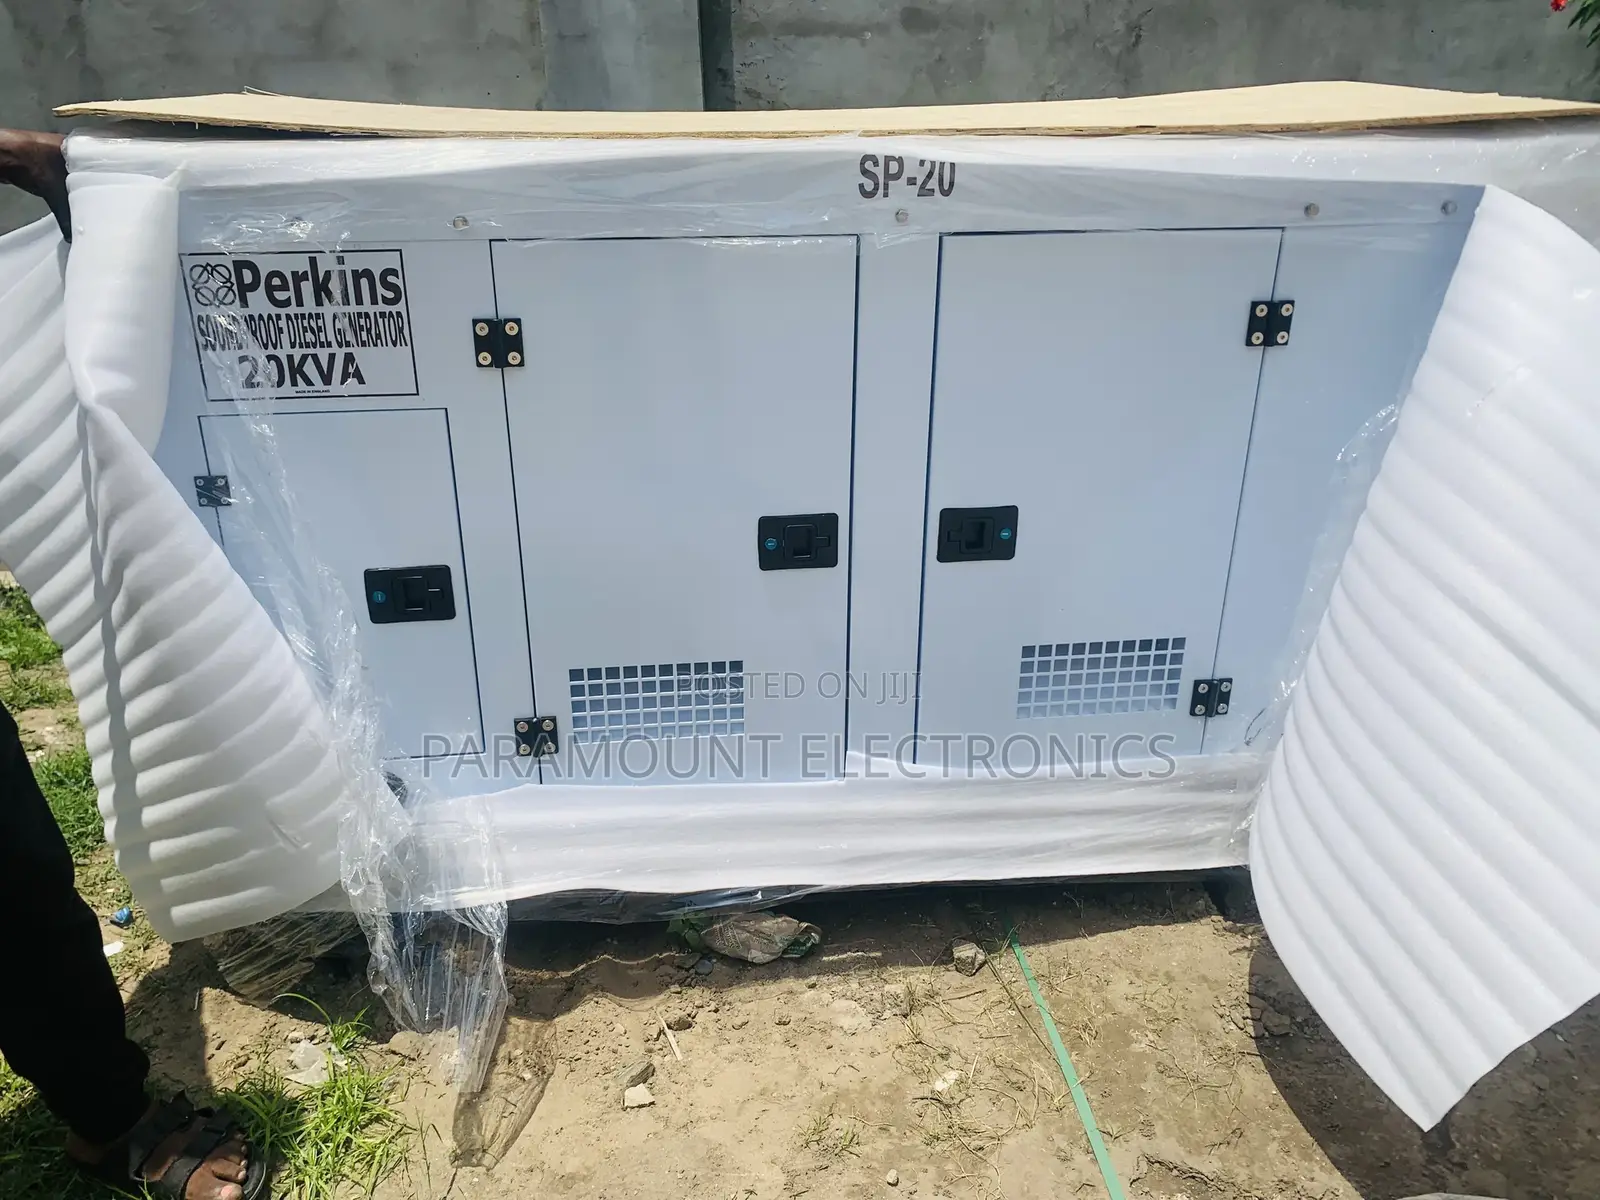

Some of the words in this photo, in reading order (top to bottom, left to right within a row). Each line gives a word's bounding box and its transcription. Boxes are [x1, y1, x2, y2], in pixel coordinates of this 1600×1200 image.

[858, 154, 956, 199] SP-20
[232, 256, 402, 308] Perkins
[286, 312, 333, 349] DIESEL
[332, 310, 408, 348] GENERATOR
[238, 352, 366, 389] 20KVA
